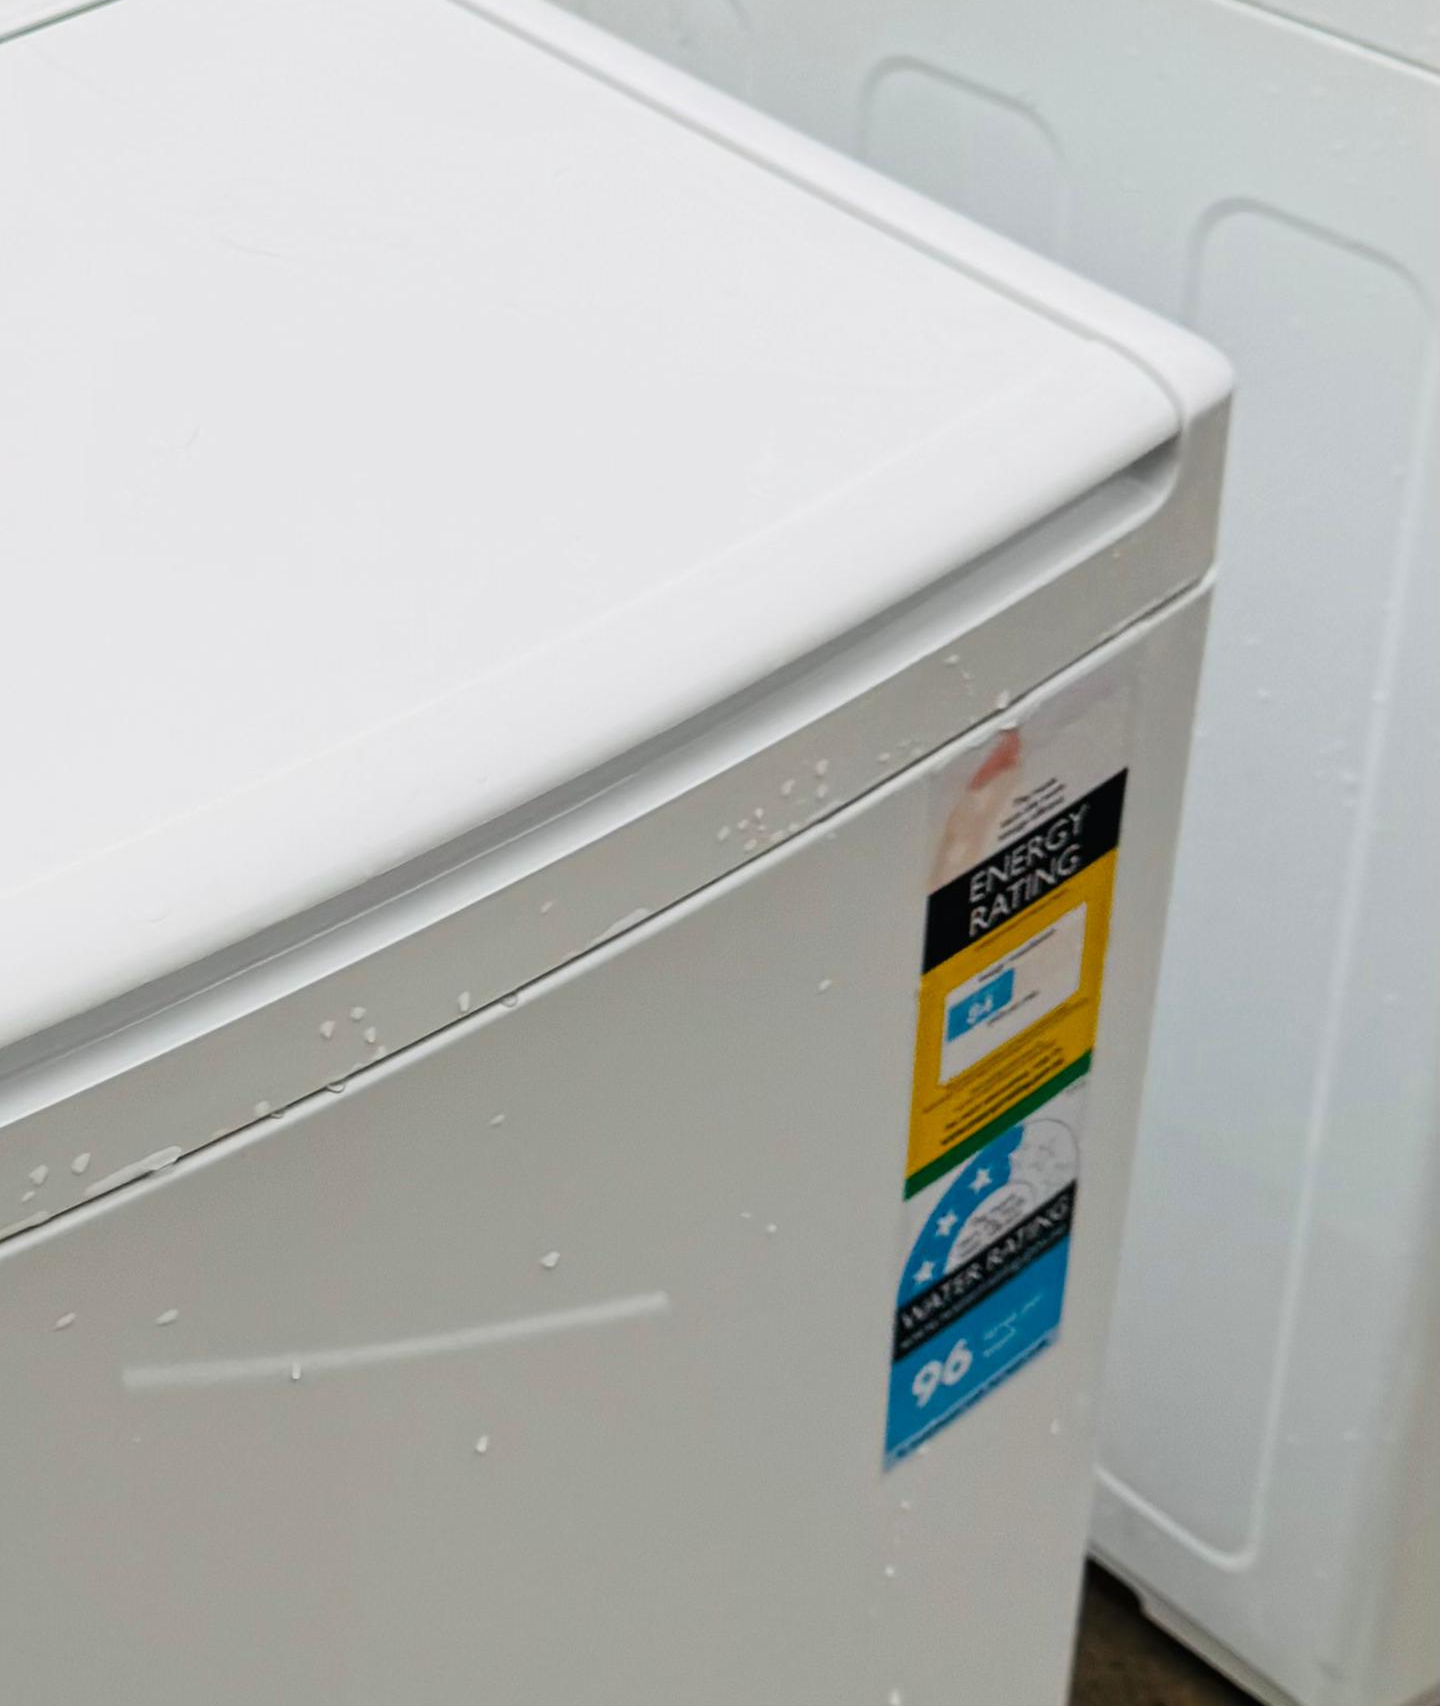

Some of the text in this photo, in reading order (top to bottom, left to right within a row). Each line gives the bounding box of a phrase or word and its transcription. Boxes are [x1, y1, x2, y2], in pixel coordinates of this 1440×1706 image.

[969, 803, 1090, 904] ENERGY
[969, 844, 1080, 938] RATING
[912, 1337, 973, 1409] 96
